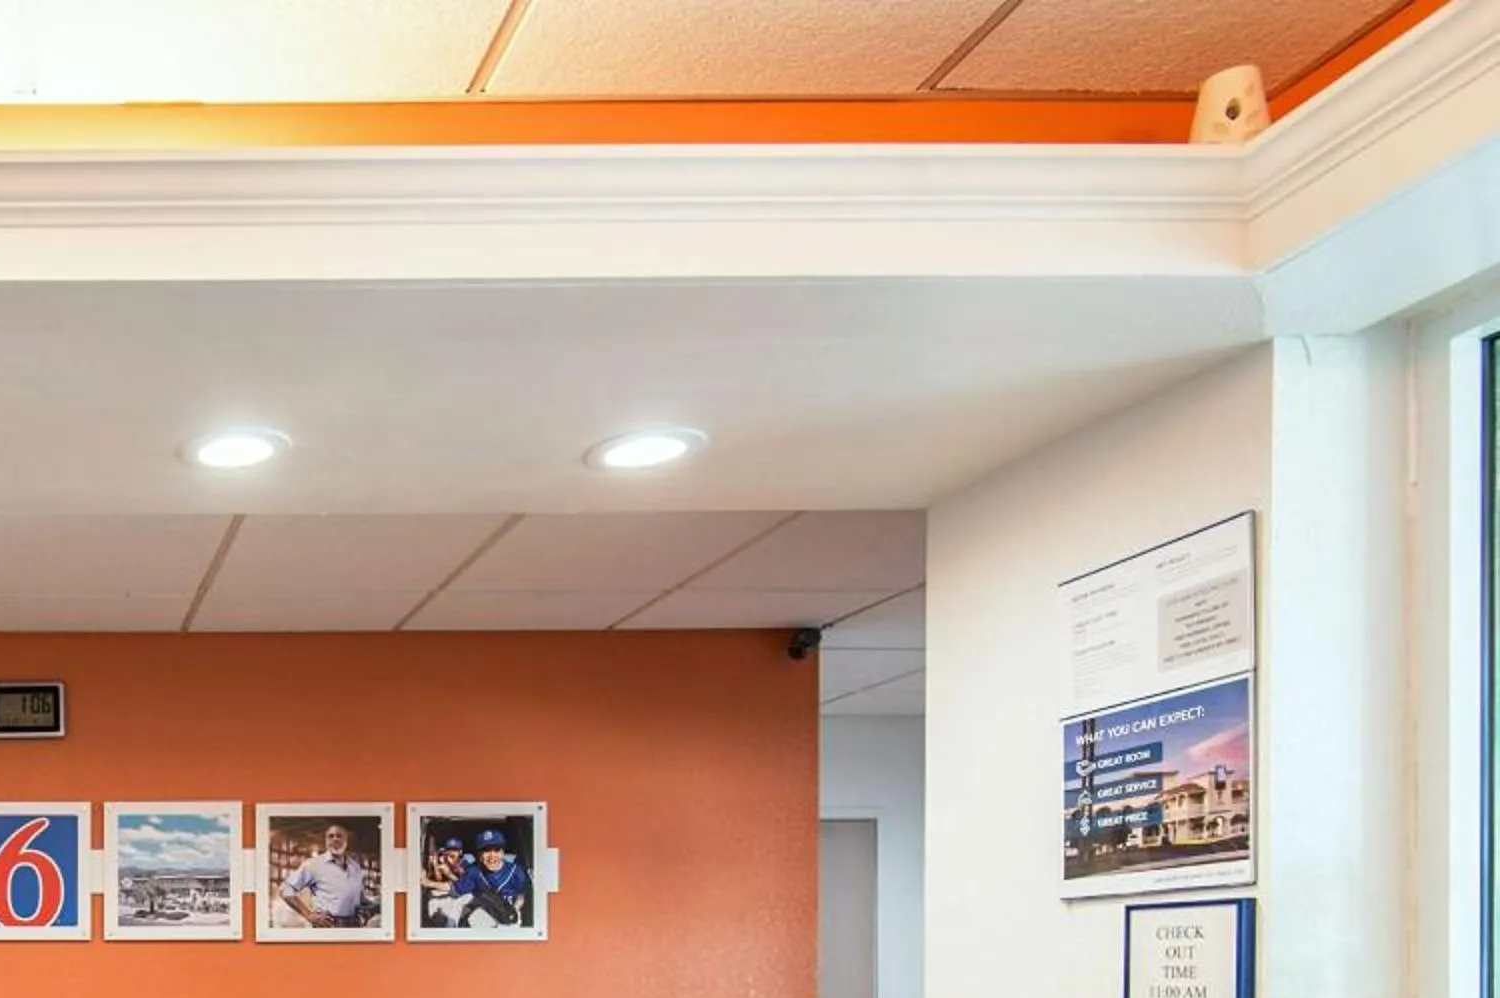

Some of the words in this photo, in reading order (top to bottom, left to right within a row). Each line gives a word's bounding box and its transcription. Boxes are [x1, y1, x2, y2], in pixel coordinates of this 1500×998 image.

[1076, 730, 1105, 746] WHAT
[1108, 723, 1130, 738] YOU
[1132, 718, 1157, 733] CAN
[1159, 705, 1205, 727] EXPECT:
[1098, 755, 1123, 769] GREAT
[1098, 785, 1123, 798] GREAT
[1155, 925, 1205, 940] CHECK
[1165, 945, 1195, 960] OUT
[1162, 965, 1197, 980] TIME
